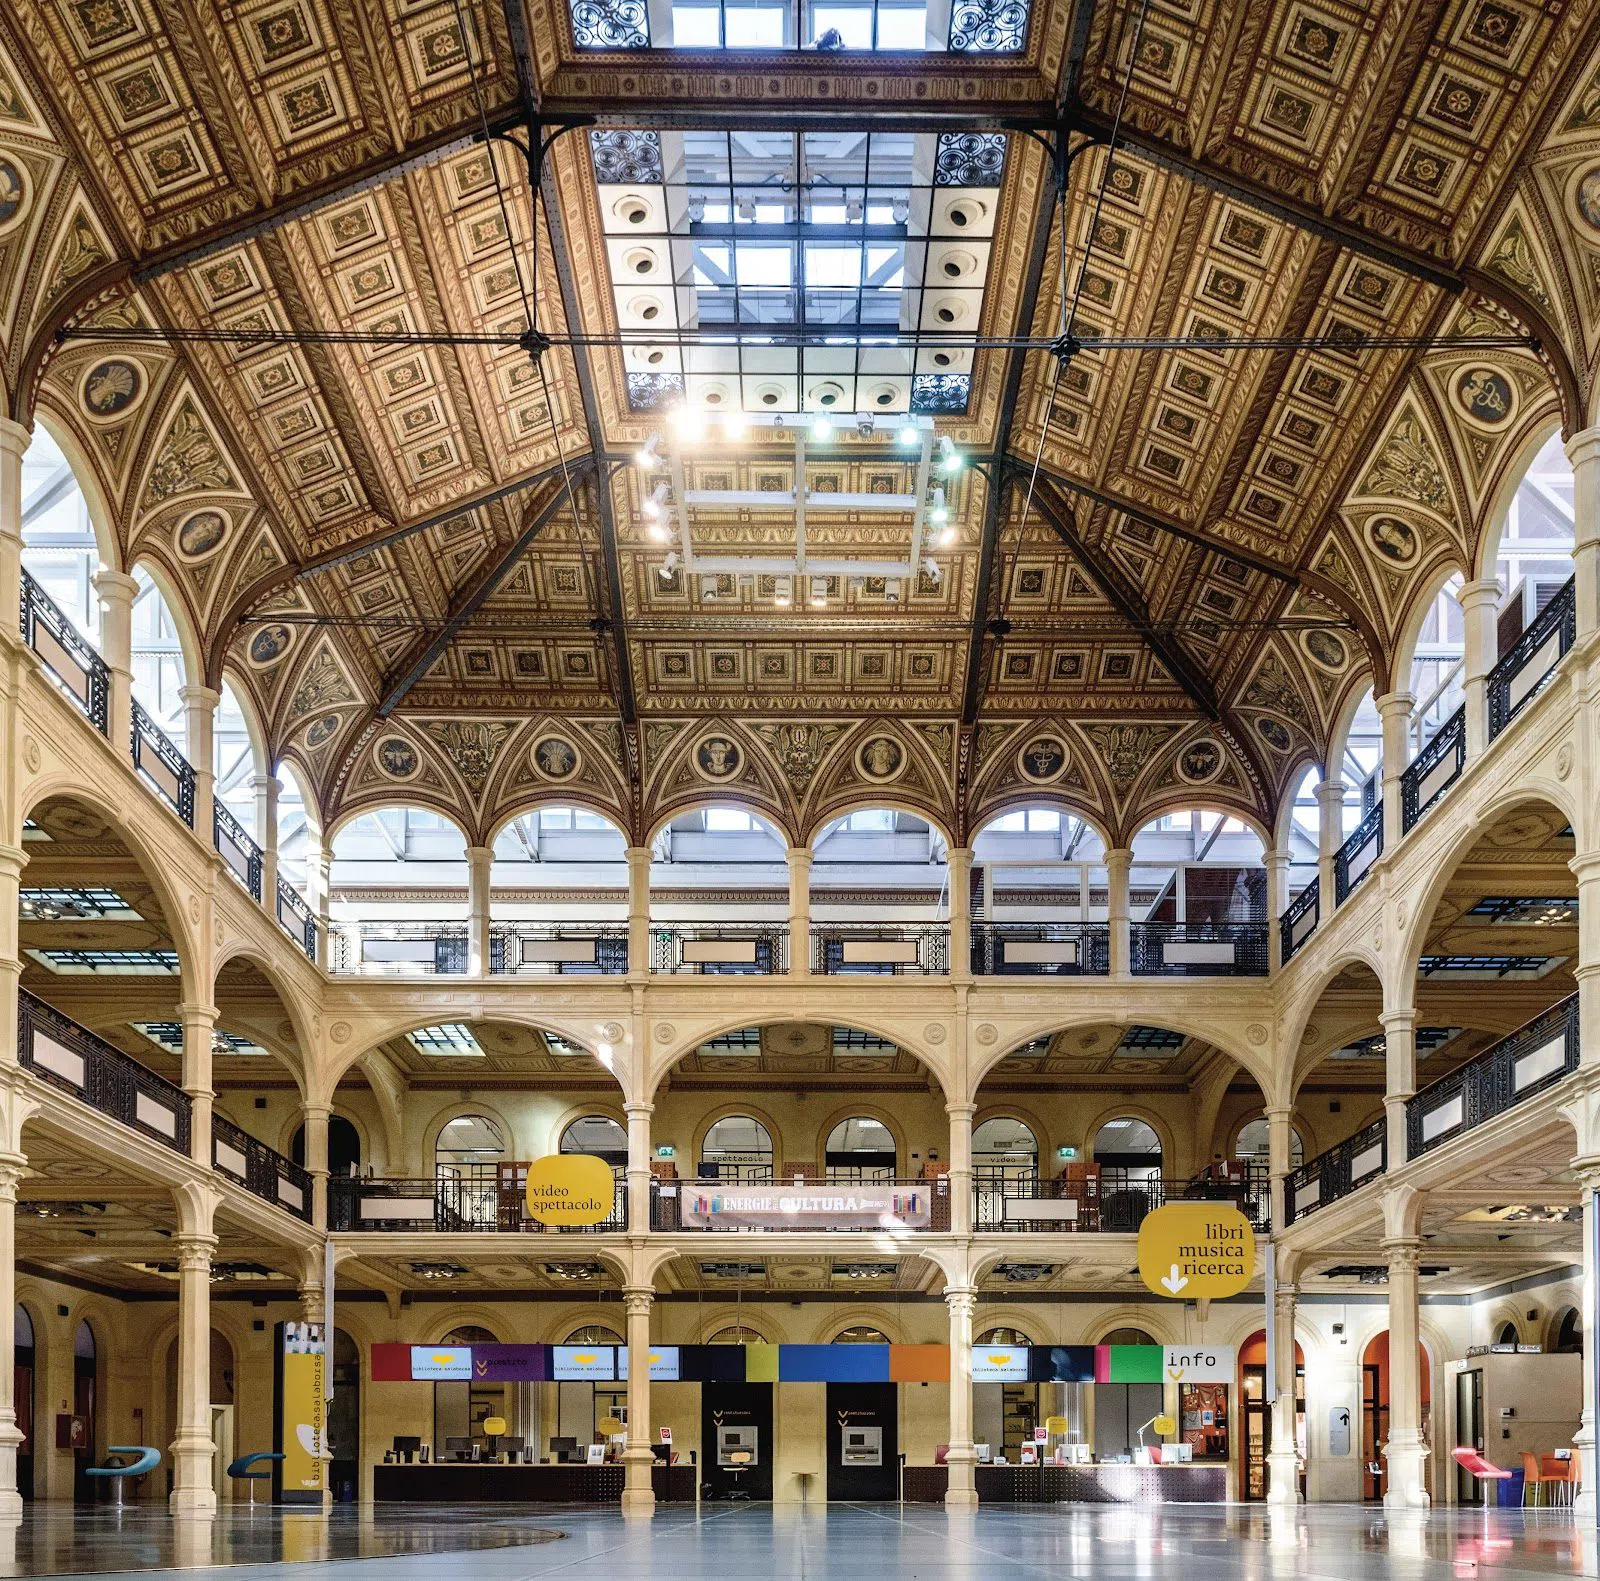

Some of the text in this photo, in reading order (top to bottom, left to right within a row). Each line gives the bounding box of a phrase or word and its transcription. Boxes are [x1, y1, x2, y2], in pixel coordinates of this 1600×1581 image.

[533, 1184, 569, 1197] video
[533, 1198, 602, 1213] spettacolo
[723, 1197, 773, 1211] ENERGIE
[1205, 1223, 1245, 1240] libri
[1178, 1241, 1245, 1257] musica
[1183, 1259, 1245, 1275] ricerca
[1167, 1352, 1216, 1367] info
